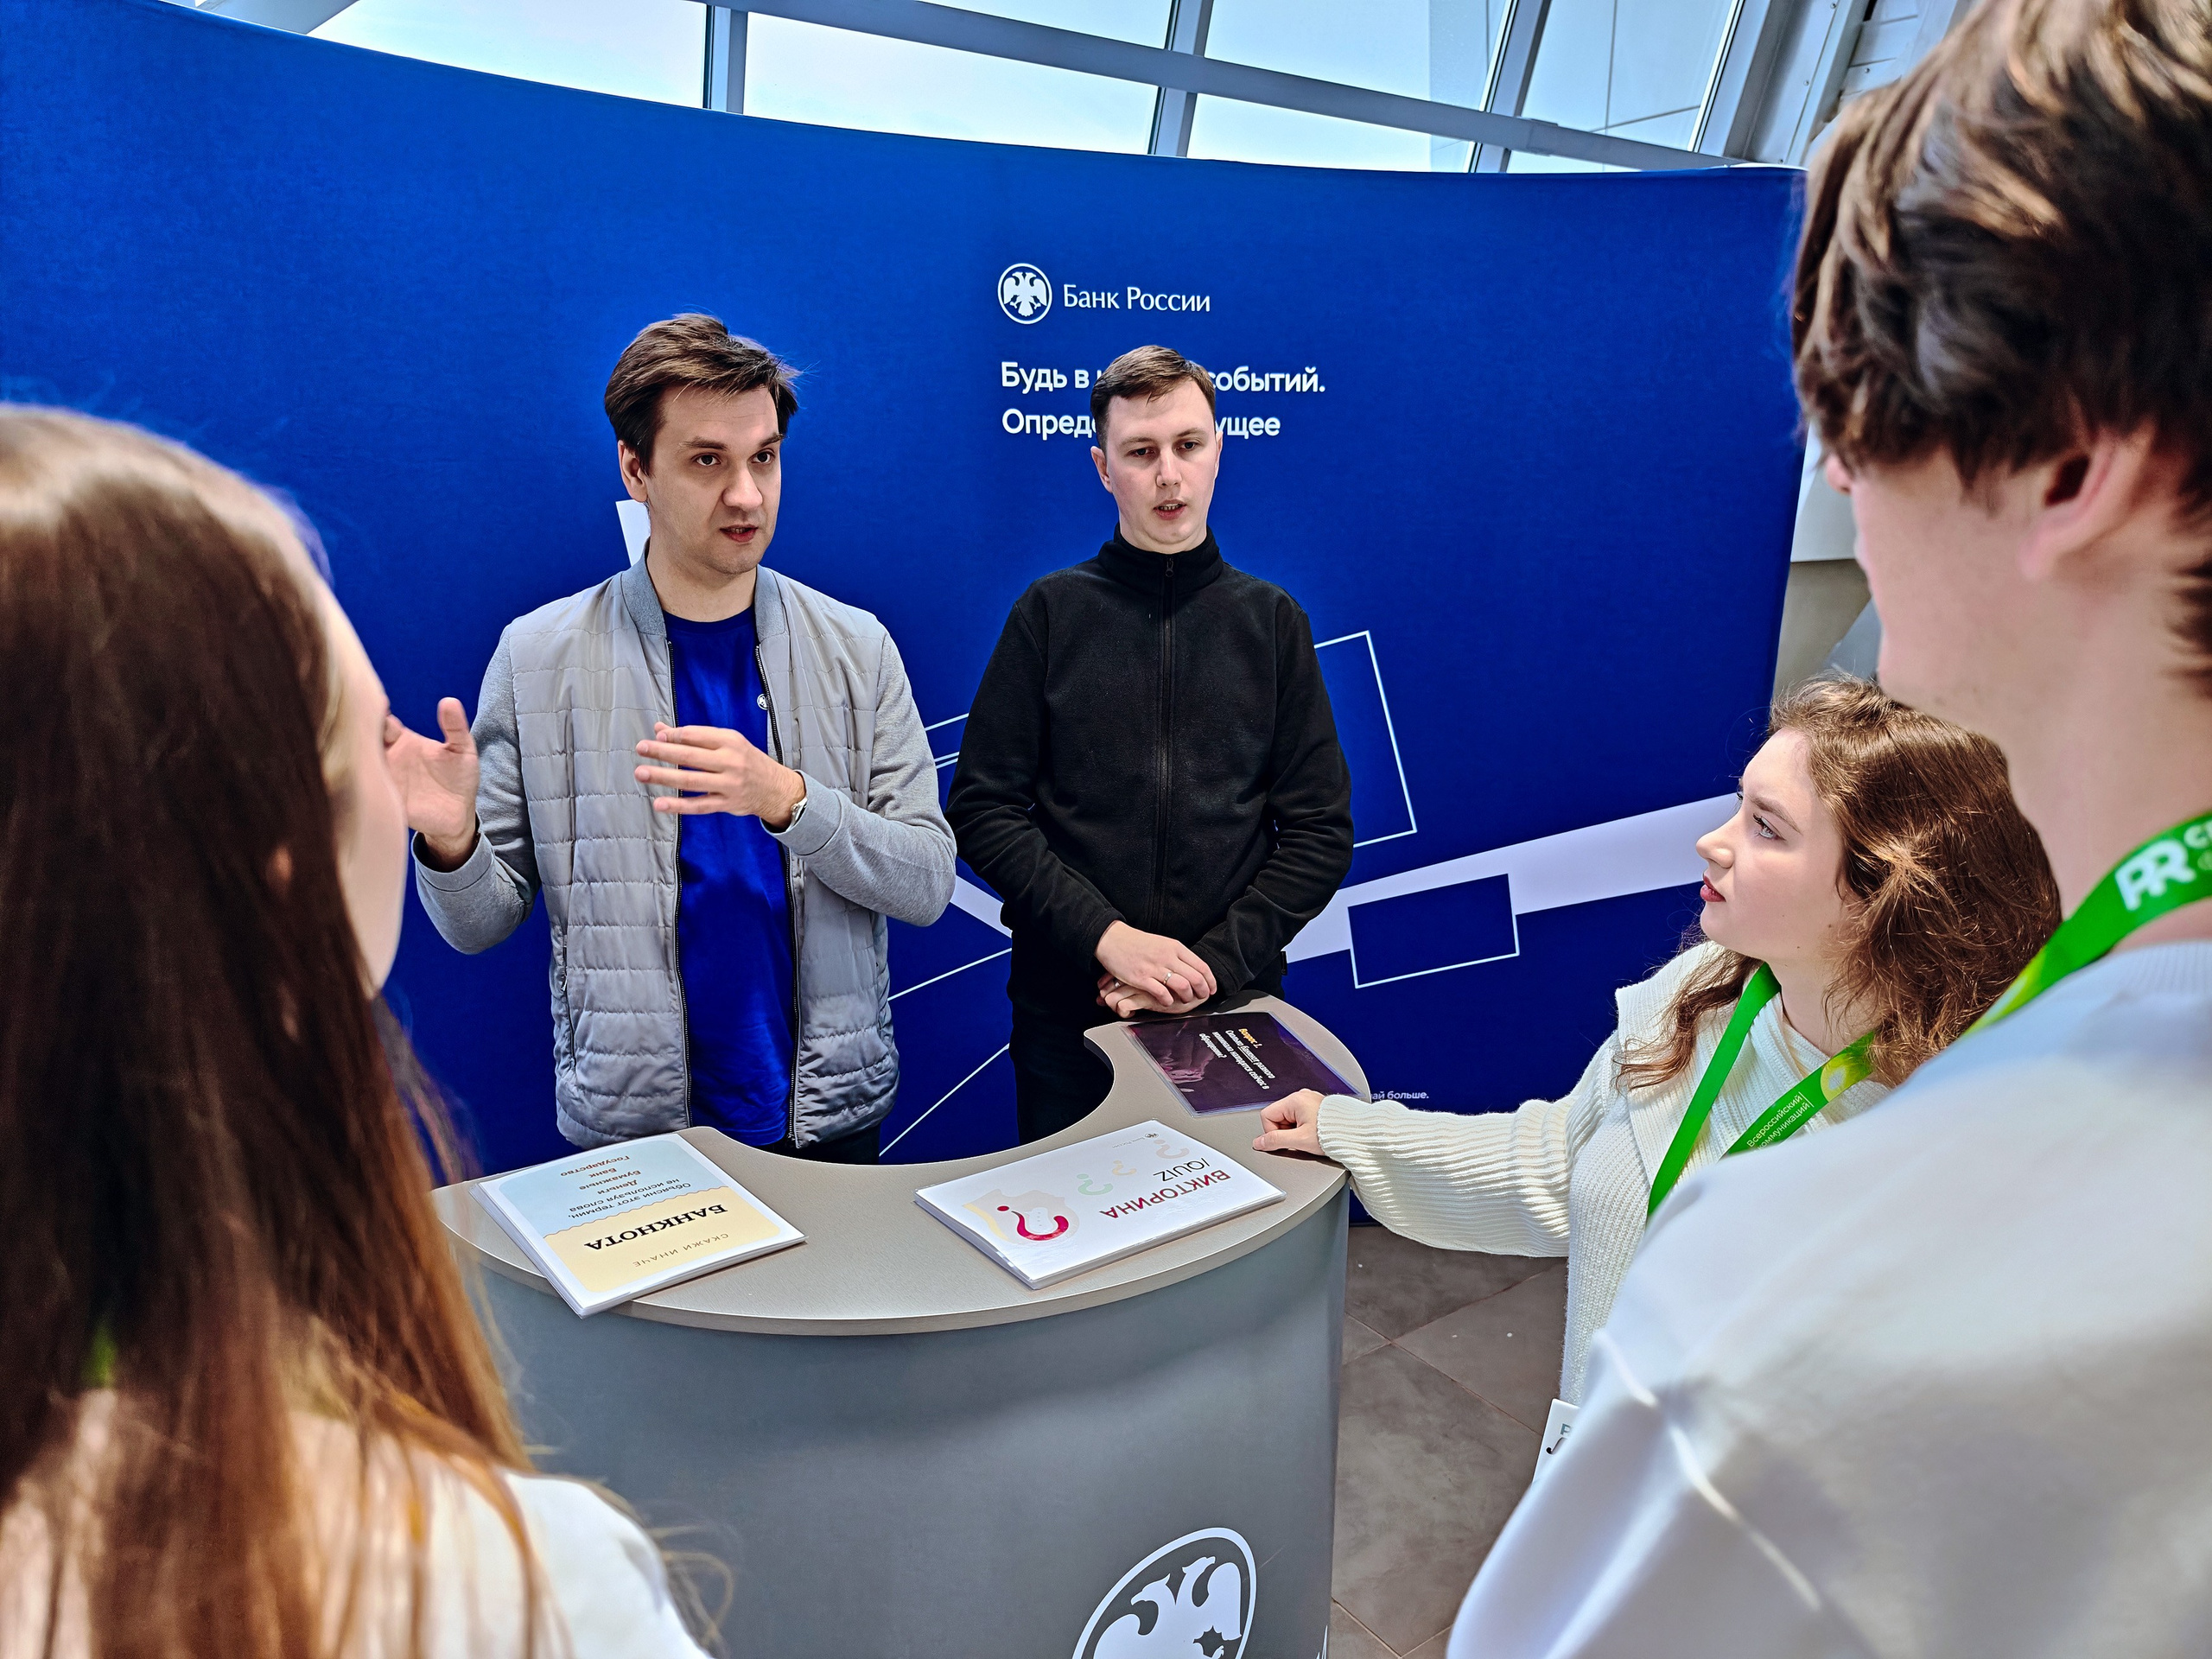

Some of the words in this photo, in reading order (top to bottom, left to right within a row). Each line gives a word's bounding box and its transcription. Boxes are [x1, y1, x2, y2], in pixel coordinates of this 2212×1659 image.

[1064, 283, 1119, 309] Банк
[1128, 286, 1211, 312] России
[1001, 361, 1068, 394] Будь
[1074, 370, 1090, 389] в
[1001, 408, 1096, 441] Опред
[1225, 1030, 1243, 1046] Сколько
[1238, 1029, 1257, 1043] Вопрос
[1387, 1090, 1429, 1099] больше.
[1746, 1095, 1803, 1147] Всероссийский
[560, 1155, 630, 1177] Государство
[588, 1167, 617, 1179] Банк
[1153, 1158, 1210, 1182] /QUIZ
[579, 1170, 641, 1191] Бумажные
[597, 1179, 638, 1196] Деньги
[643, 1182, 691, 1198] Объясни
[606, 1182, 662, 1202] используя
[617, 1196, 640, 1206] этот
[1099, 1170, 1230, 1218] ВИКТОРИНА
[569, 1200, 604, 1213] слова
[584, 1205, 728, 1250] БАНКНОТА
[683, 1233, 728, 1251] СКАЖИ
[632, 1249, 678, 1267] ИНАЧЕ
